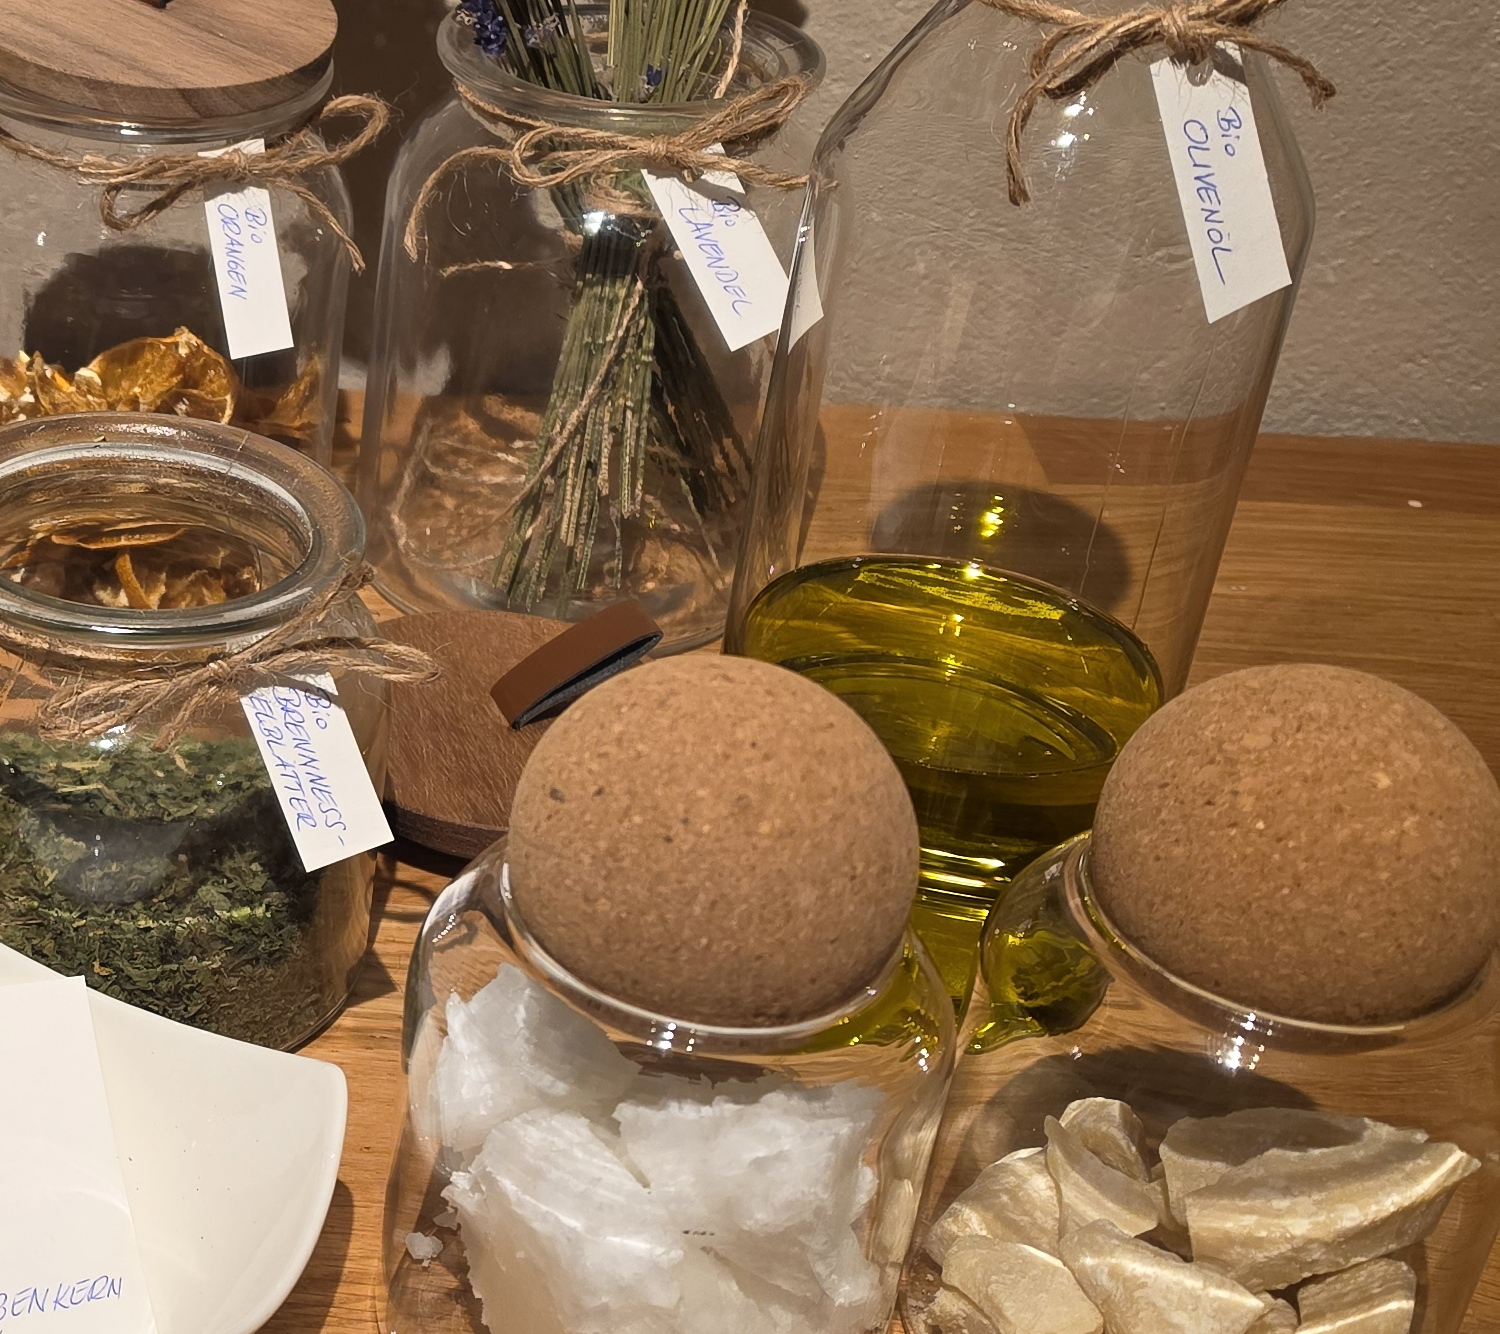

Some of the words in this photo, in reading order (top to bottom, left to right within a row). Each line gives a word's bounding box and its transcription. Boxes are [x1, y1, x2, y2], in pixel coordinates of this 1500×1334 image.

[1217, 105, 1242, 157] Bio
[245, 208, 268, 244] Bio
[1183, 119, 1232, 286] OLIVENÖL
[217, 202, 248, 301] ORANGEN
[678, 206, 753, 318] LAVENDEL
[304, 686, 332, 730] Bio
